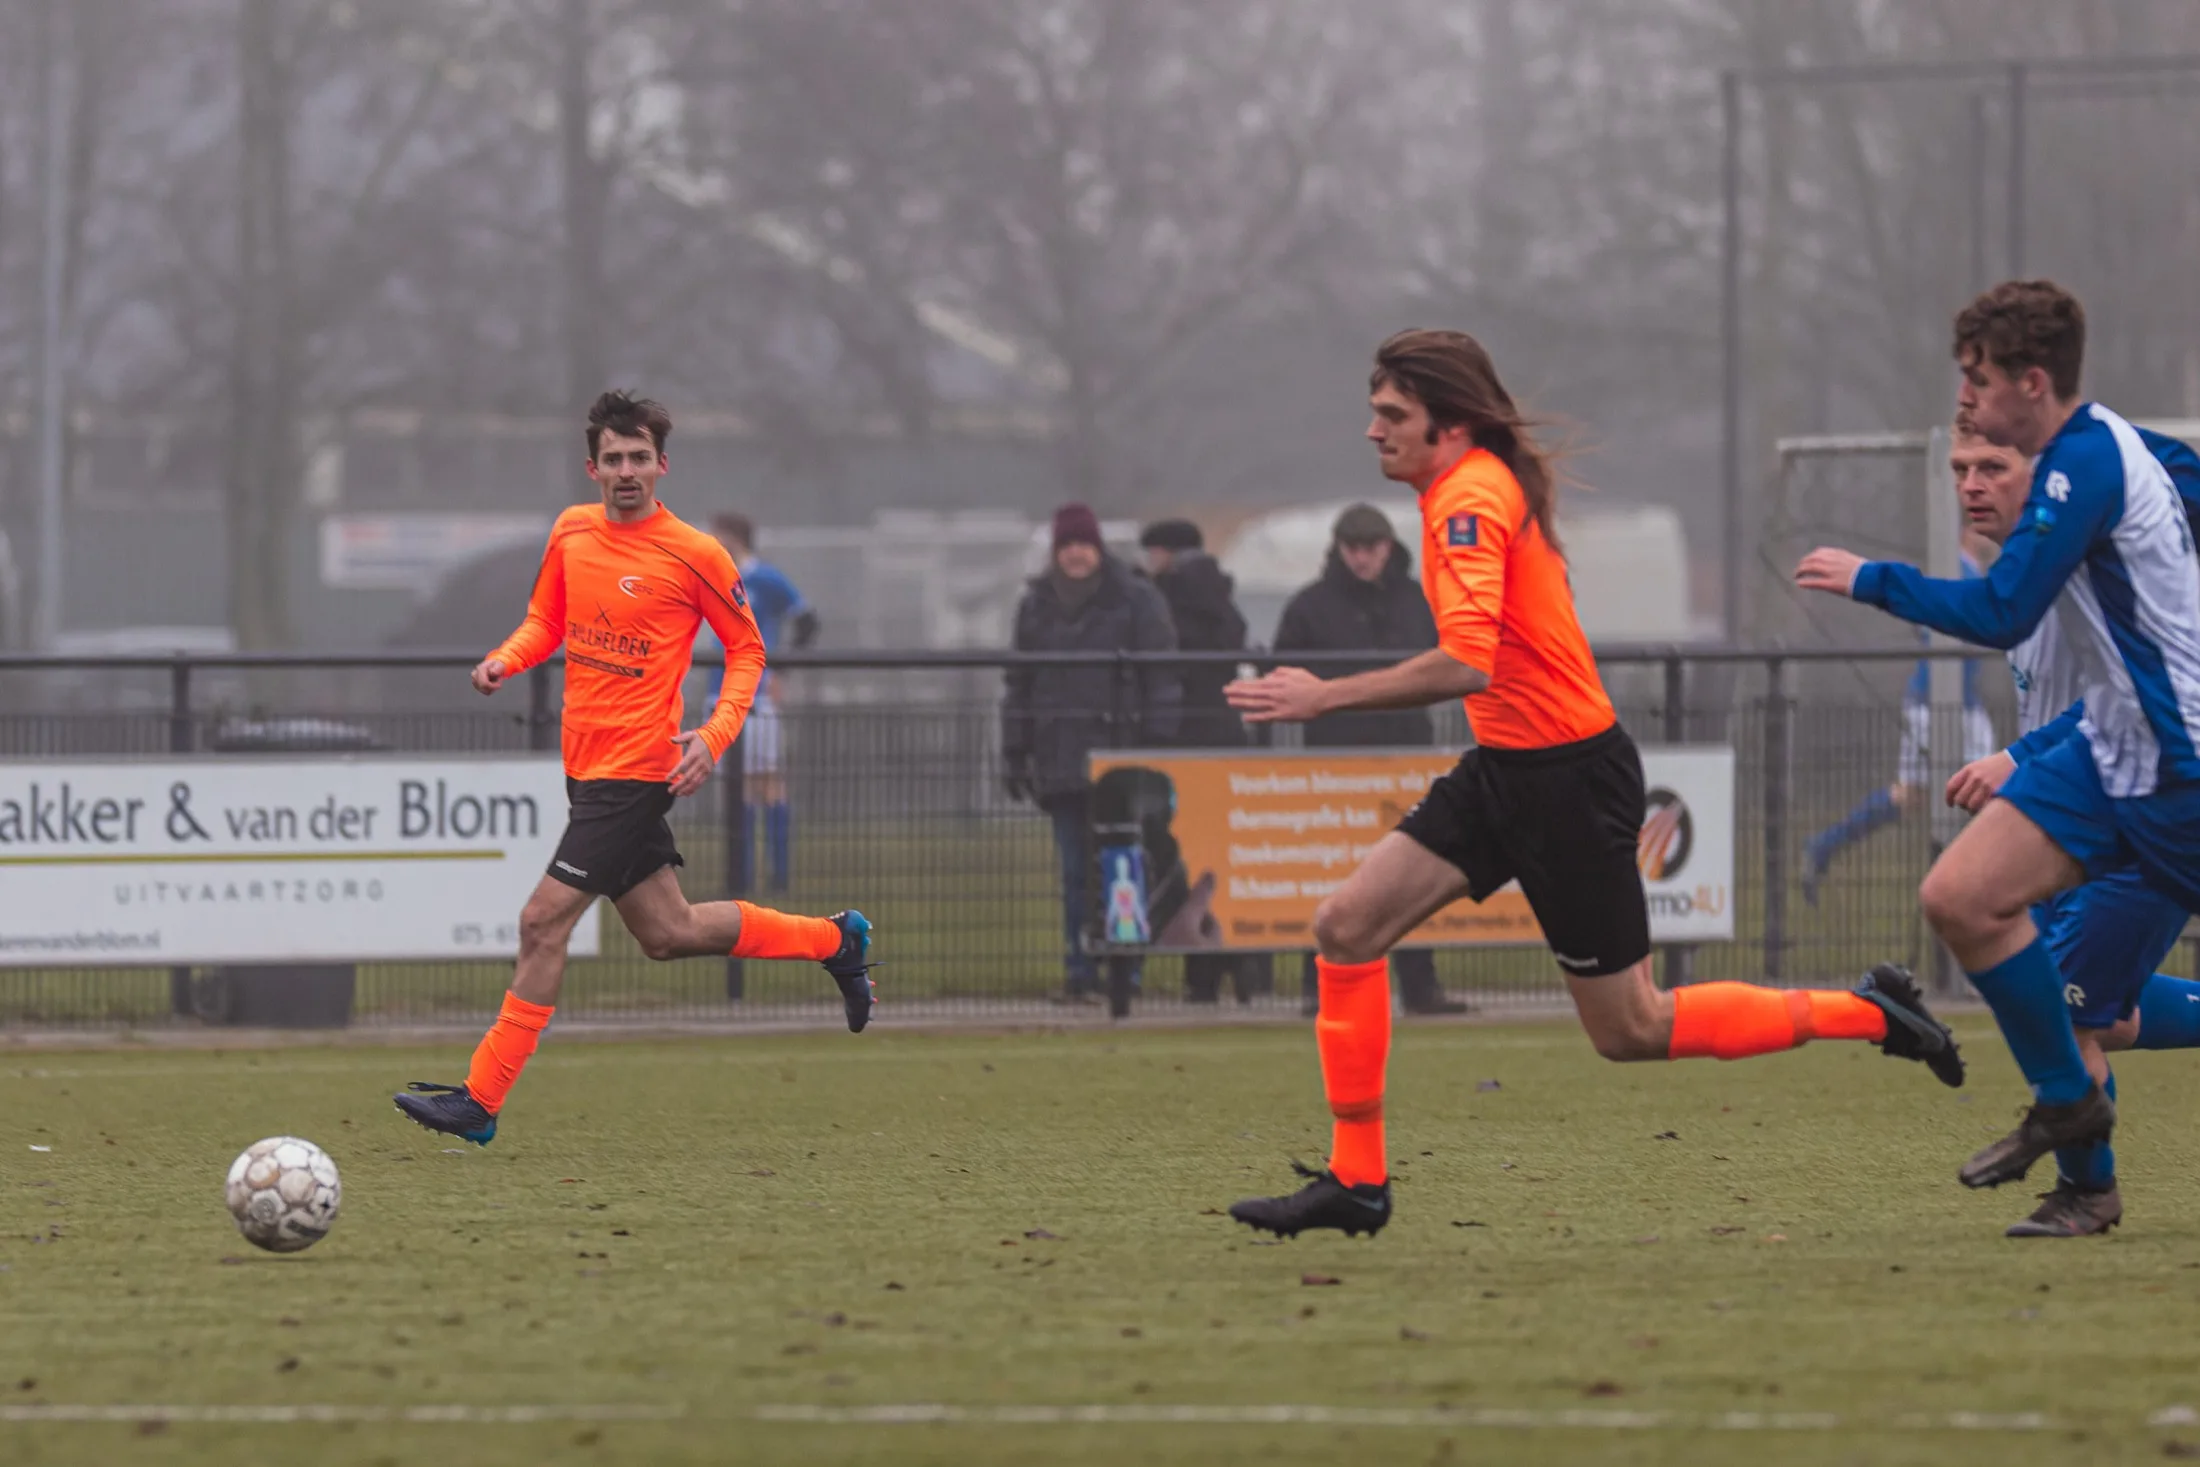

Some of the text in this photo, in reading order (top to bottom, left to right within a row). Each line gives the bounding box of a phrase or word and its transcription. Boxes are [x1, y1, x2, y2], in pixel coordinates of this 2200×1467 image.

[0, 778, 539, 843] akker & van der Blom
[113, 877, 384, 906] UITVAARTZORG
